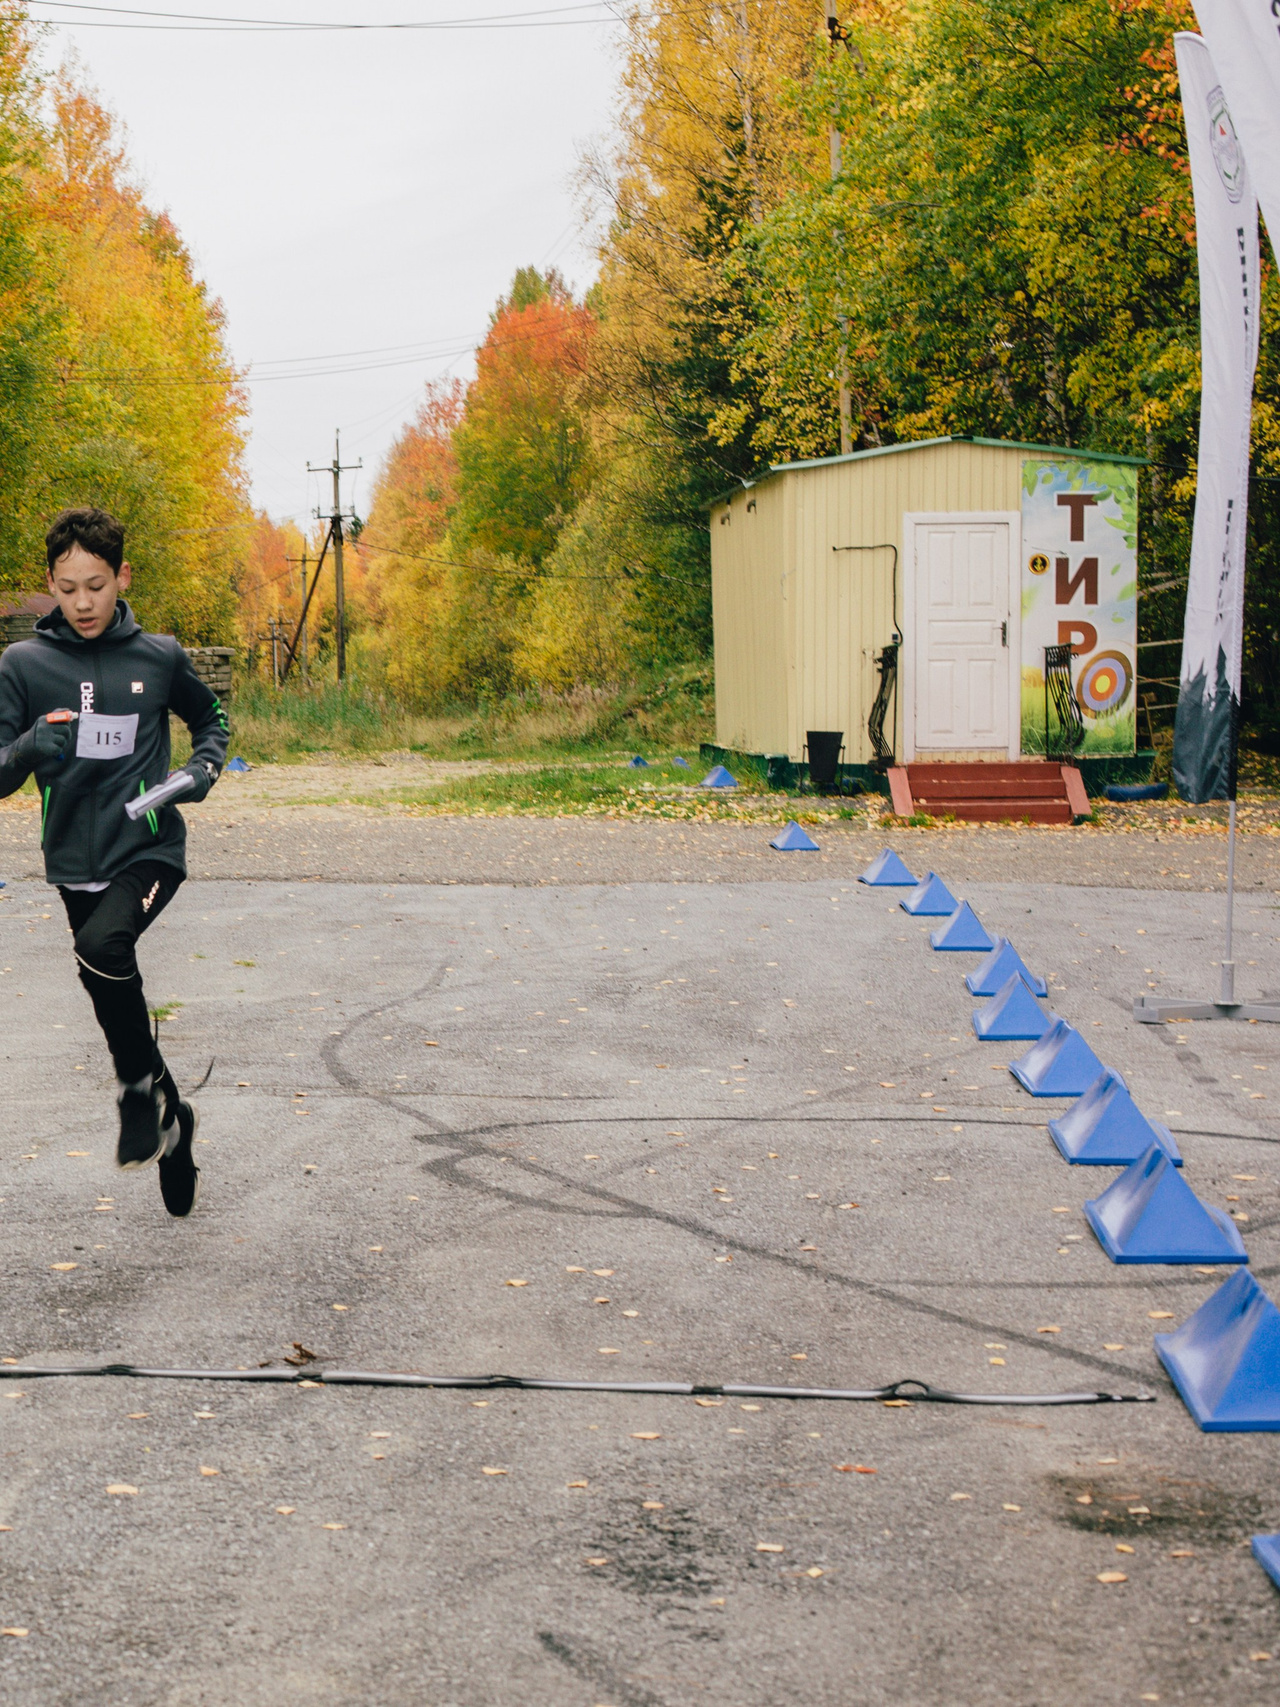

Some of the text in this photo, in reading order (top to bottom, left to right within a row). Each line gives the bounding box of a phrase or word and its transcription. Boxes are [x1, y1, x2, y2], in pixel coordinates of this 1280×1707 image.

[1055, 494, 1099, 667] ТИР
[80, 682, 94, 713] PRO
[96, 731, 122, 746] 115
